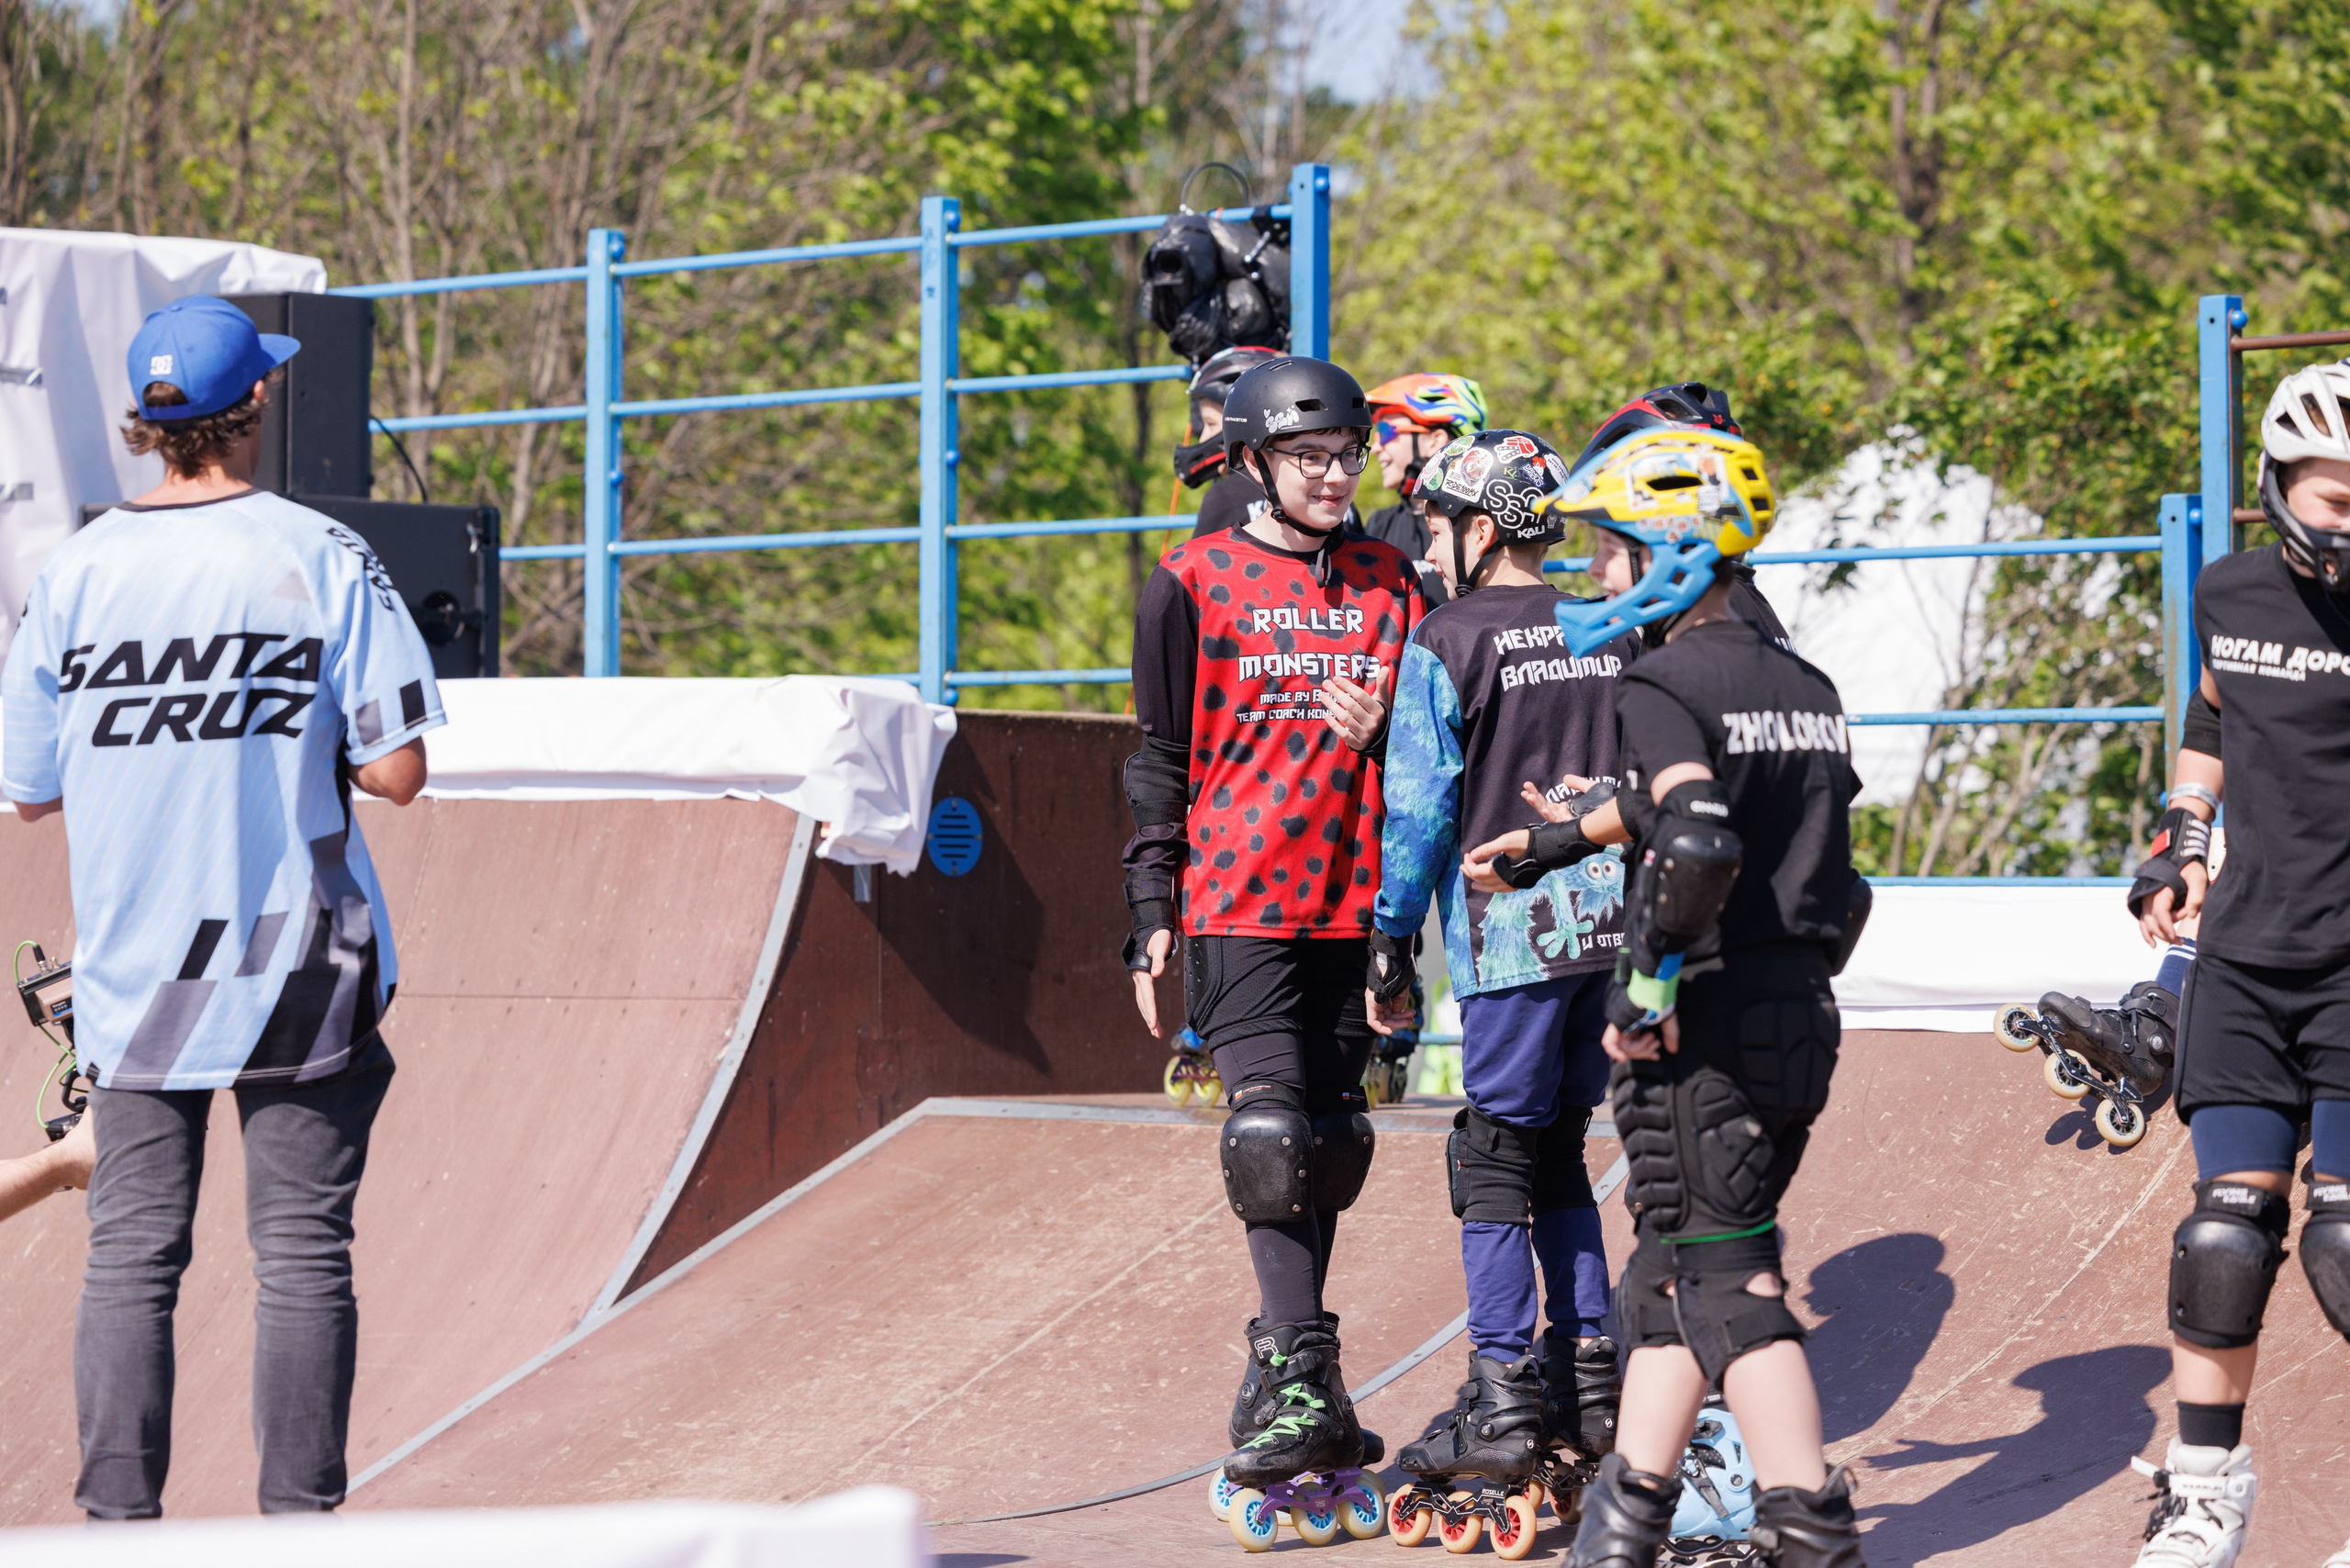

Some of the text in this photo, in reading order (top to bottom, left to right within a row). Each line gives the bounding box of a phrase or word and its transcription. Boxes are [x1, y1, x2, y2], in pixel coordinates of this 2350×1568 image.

[1516, 524, 1546, 539] KALI
[1252, 608, 1364, 634] ROLLER
[58, 632, 324, 694] SANTA
[1238, 653, 1381, 683] MONSTERS
[1500, 654, 1622, 692] ВЛАДИМИР
[1259, 691, 1292, 706] MADE
[1294, 691, 1310, 703] BY
[91, 688, 316, 747] CRUZ
[1236, 711, 1266, 723] TEAM
[1268, 709, 1305, 720] COACH
